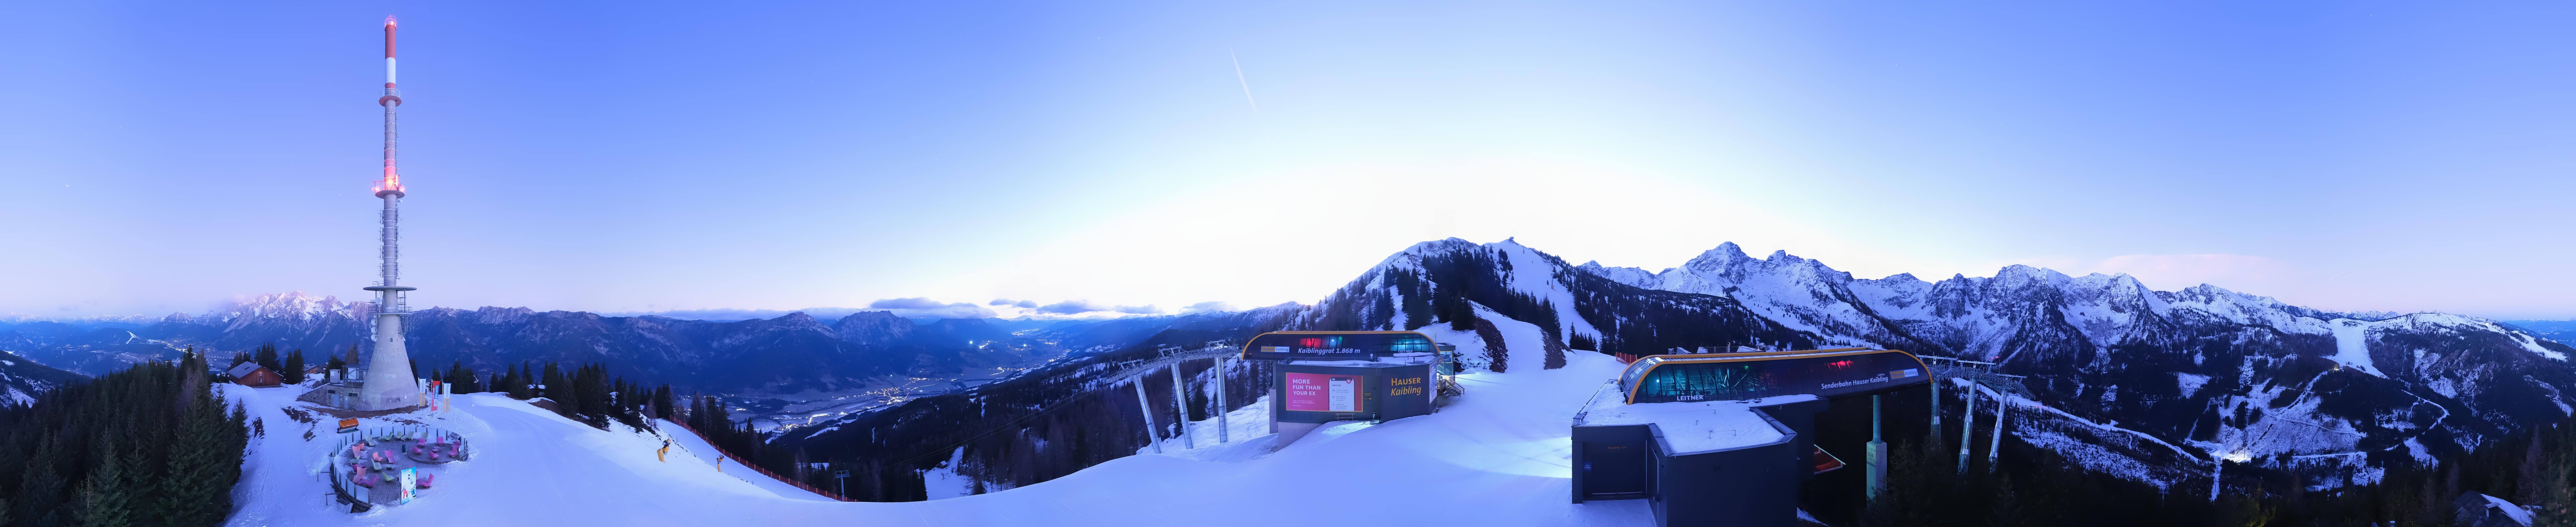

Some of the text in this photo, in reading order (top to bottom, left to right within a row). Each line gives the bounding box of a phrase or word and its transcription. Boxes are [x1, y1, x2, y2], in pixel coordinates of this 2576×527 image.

[1391, 377, 1421, 386] HAUSER
[1821, 381, 1852, 389] Senderbahn
[1391, 386, 1421, 396] Kaibling
